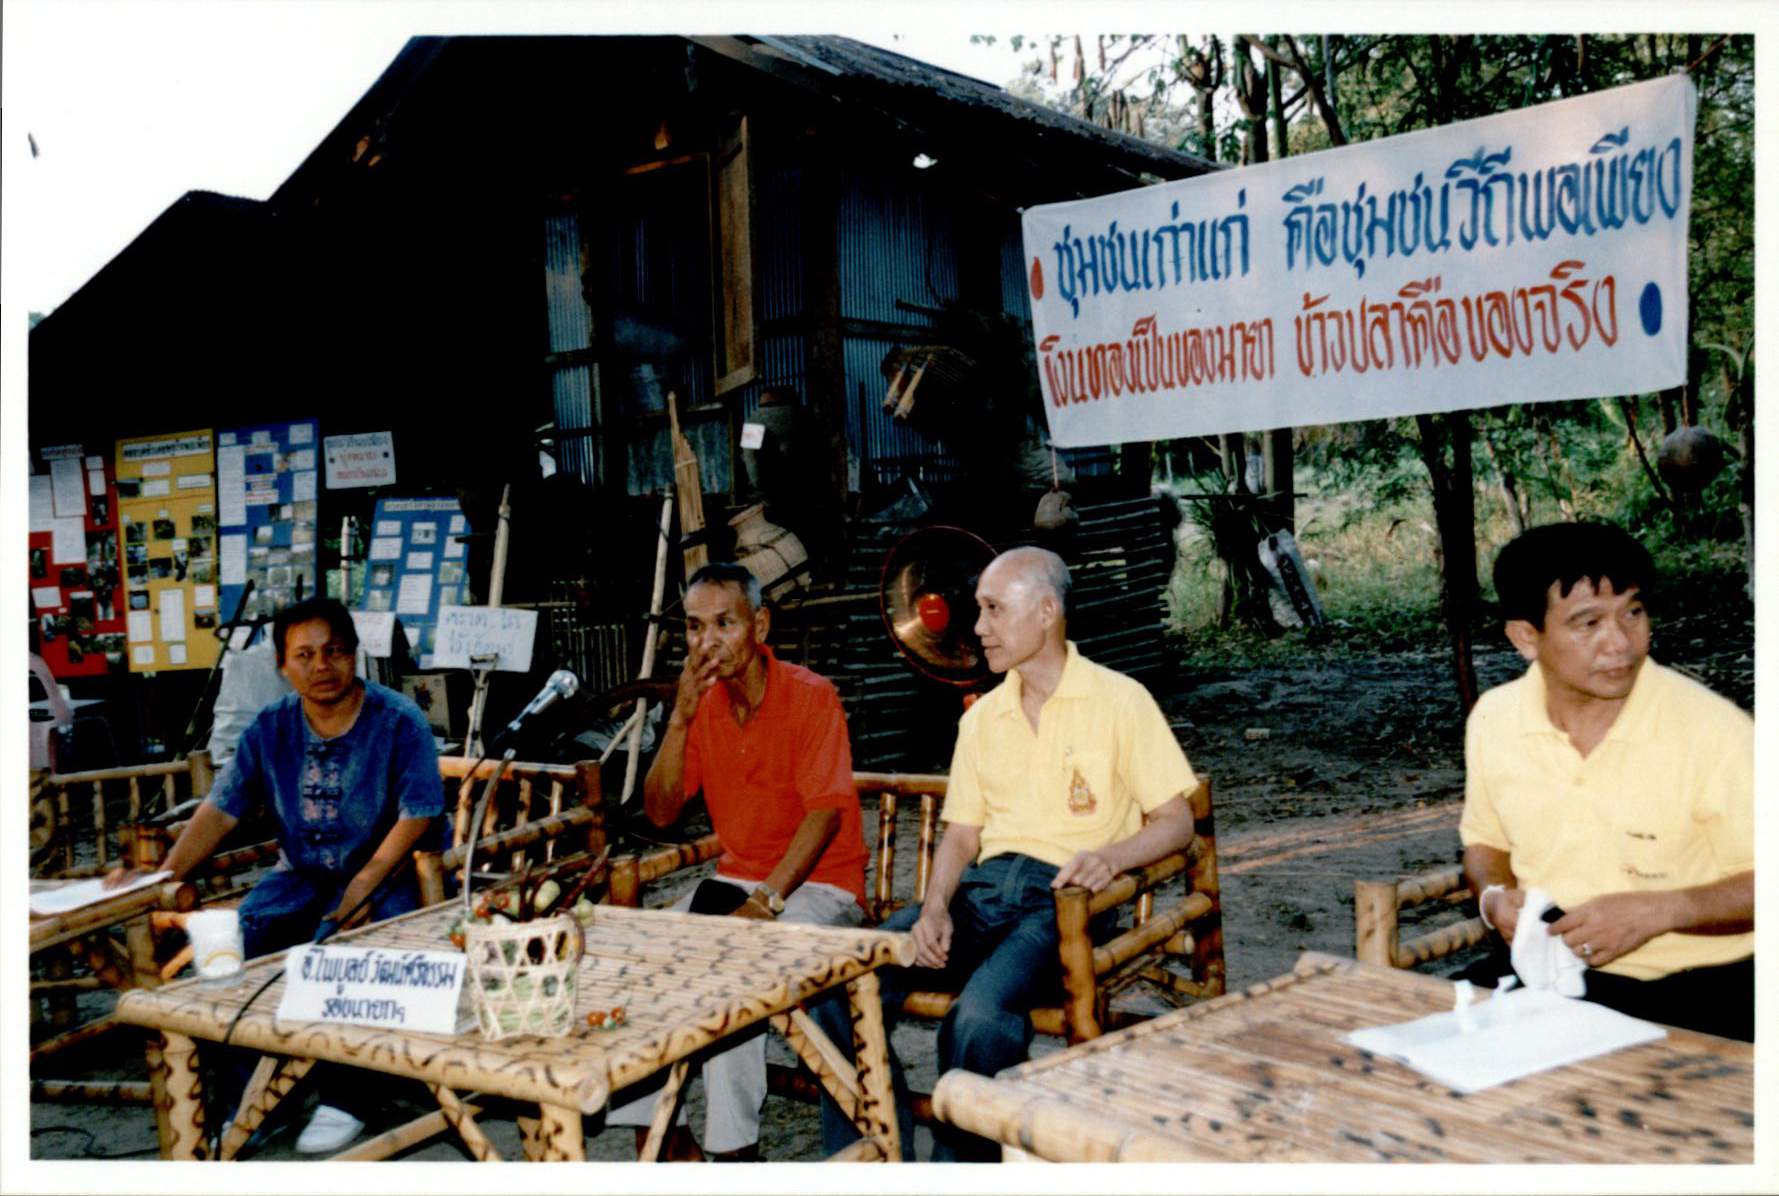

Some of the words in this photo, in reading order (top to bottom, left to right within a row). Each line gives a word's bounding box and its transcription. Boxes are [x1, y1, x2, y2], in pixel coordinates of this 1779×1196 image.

[1053, 188, 1251, 320] ชุมชนเก่าแก่
[1039, 312, 1275, 409] เงินทองเป็นของมายา
[1294, 260, 1619, 380] ข้าวปลาคือของจริง
